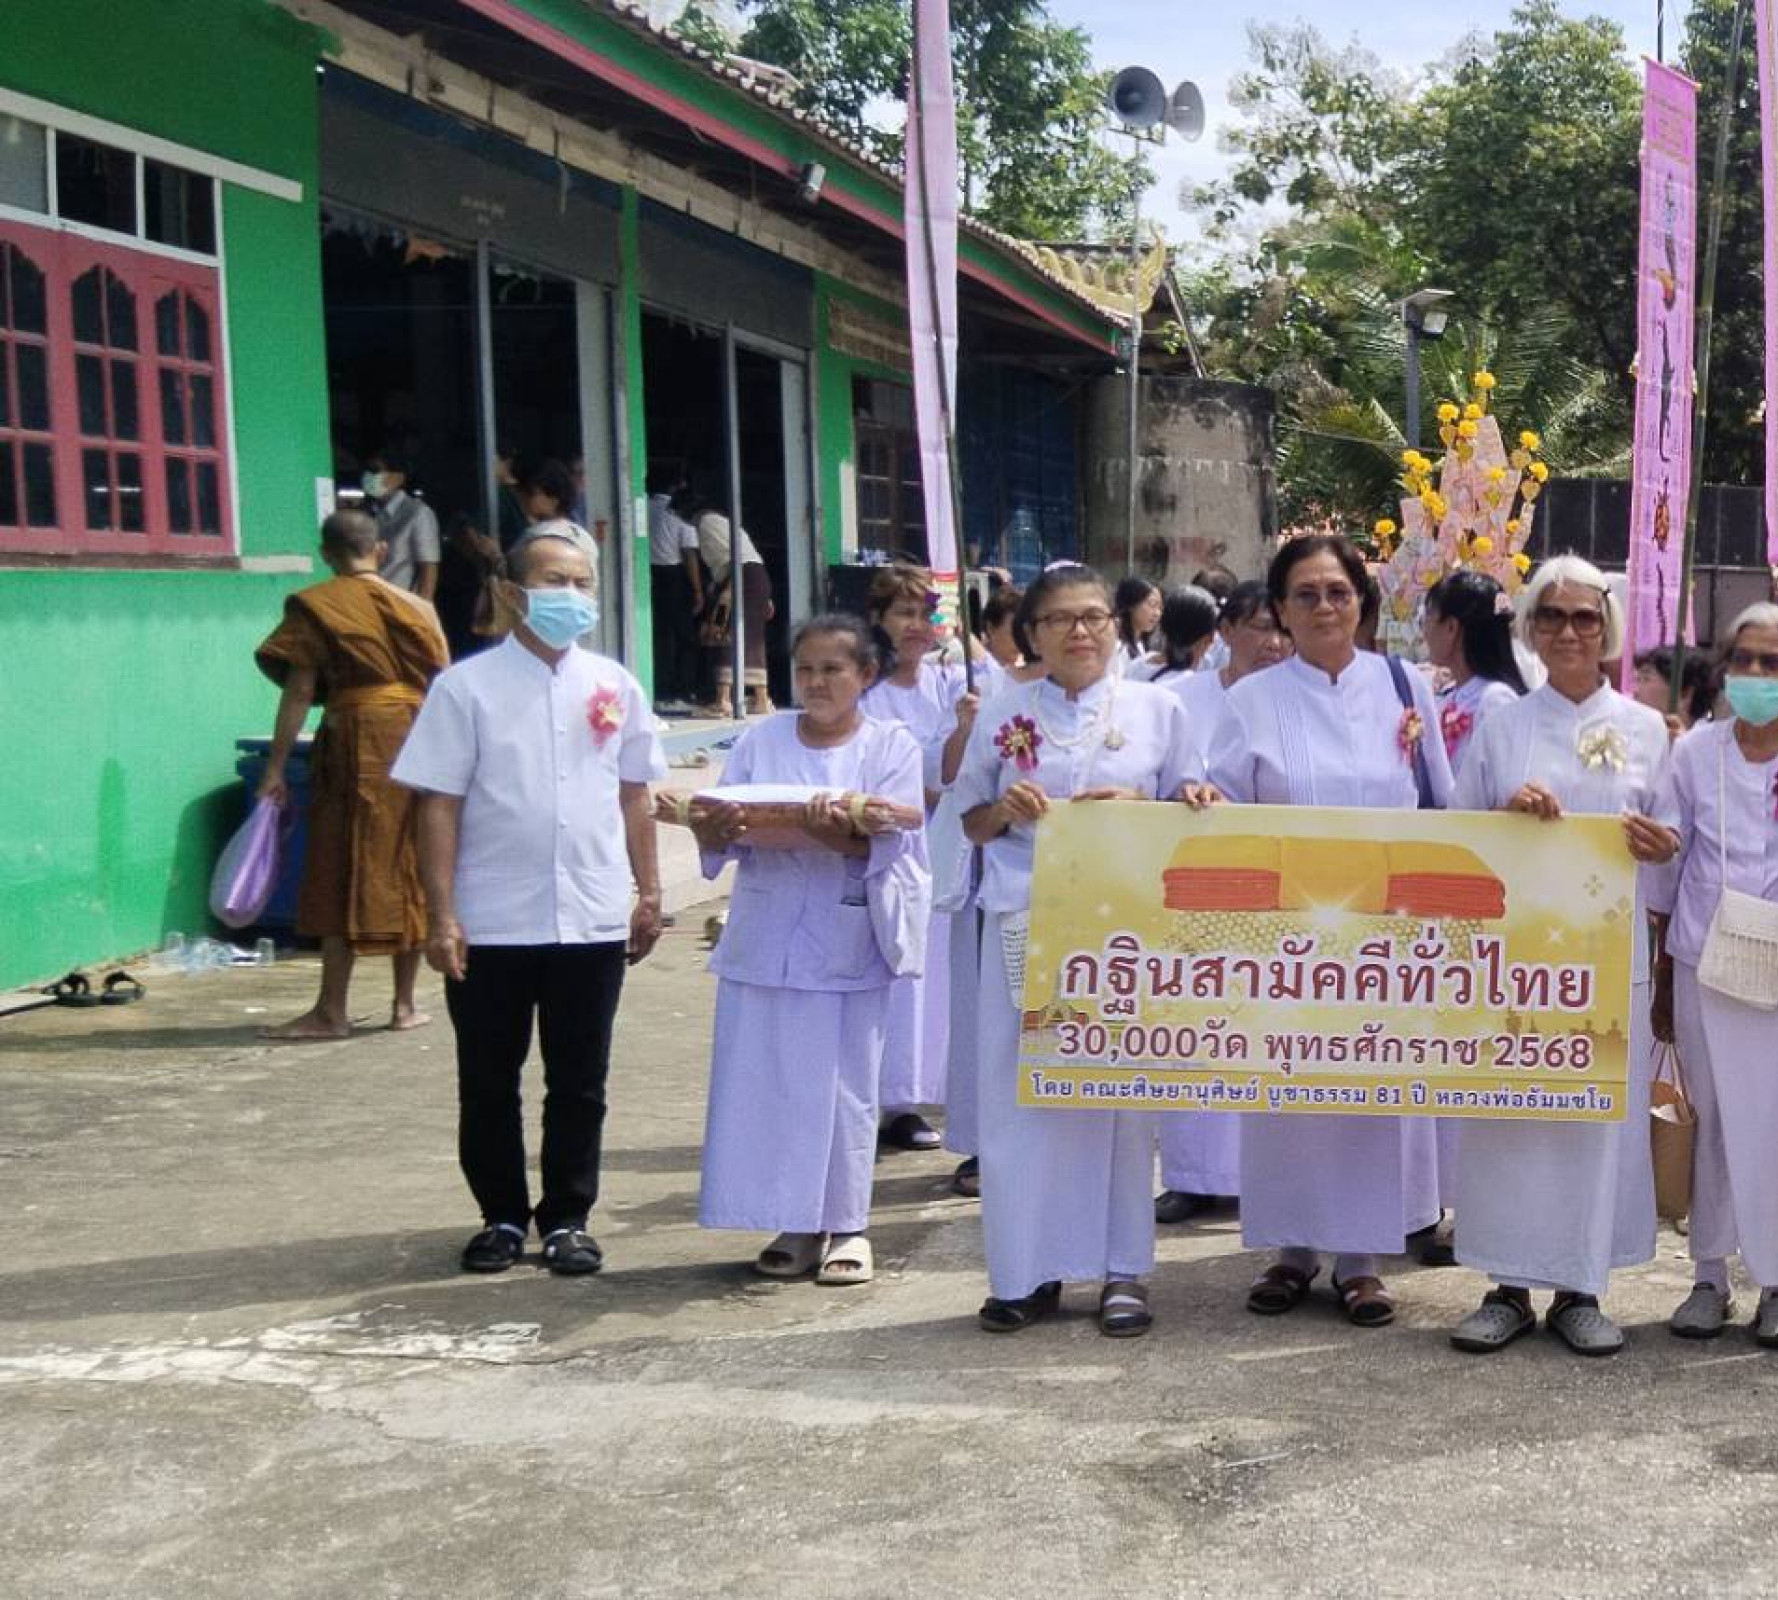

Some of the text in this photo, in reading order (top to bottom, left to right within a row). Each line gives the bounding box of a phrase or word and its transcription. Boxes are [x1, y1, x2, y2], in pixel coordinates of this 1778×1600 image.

[1066, 926, 1590, 1015] กฐินสามัคคีทั่วไทย
[1058, 1017, 1591, 1075] 30,000วัด พุทธศักราช 2568
[1032, 1072, 1612, 1110] โดย คณะศิษยานุศิษย์ บูชาธรรม 81 ปี หลวงพ่อธัมมชโย
